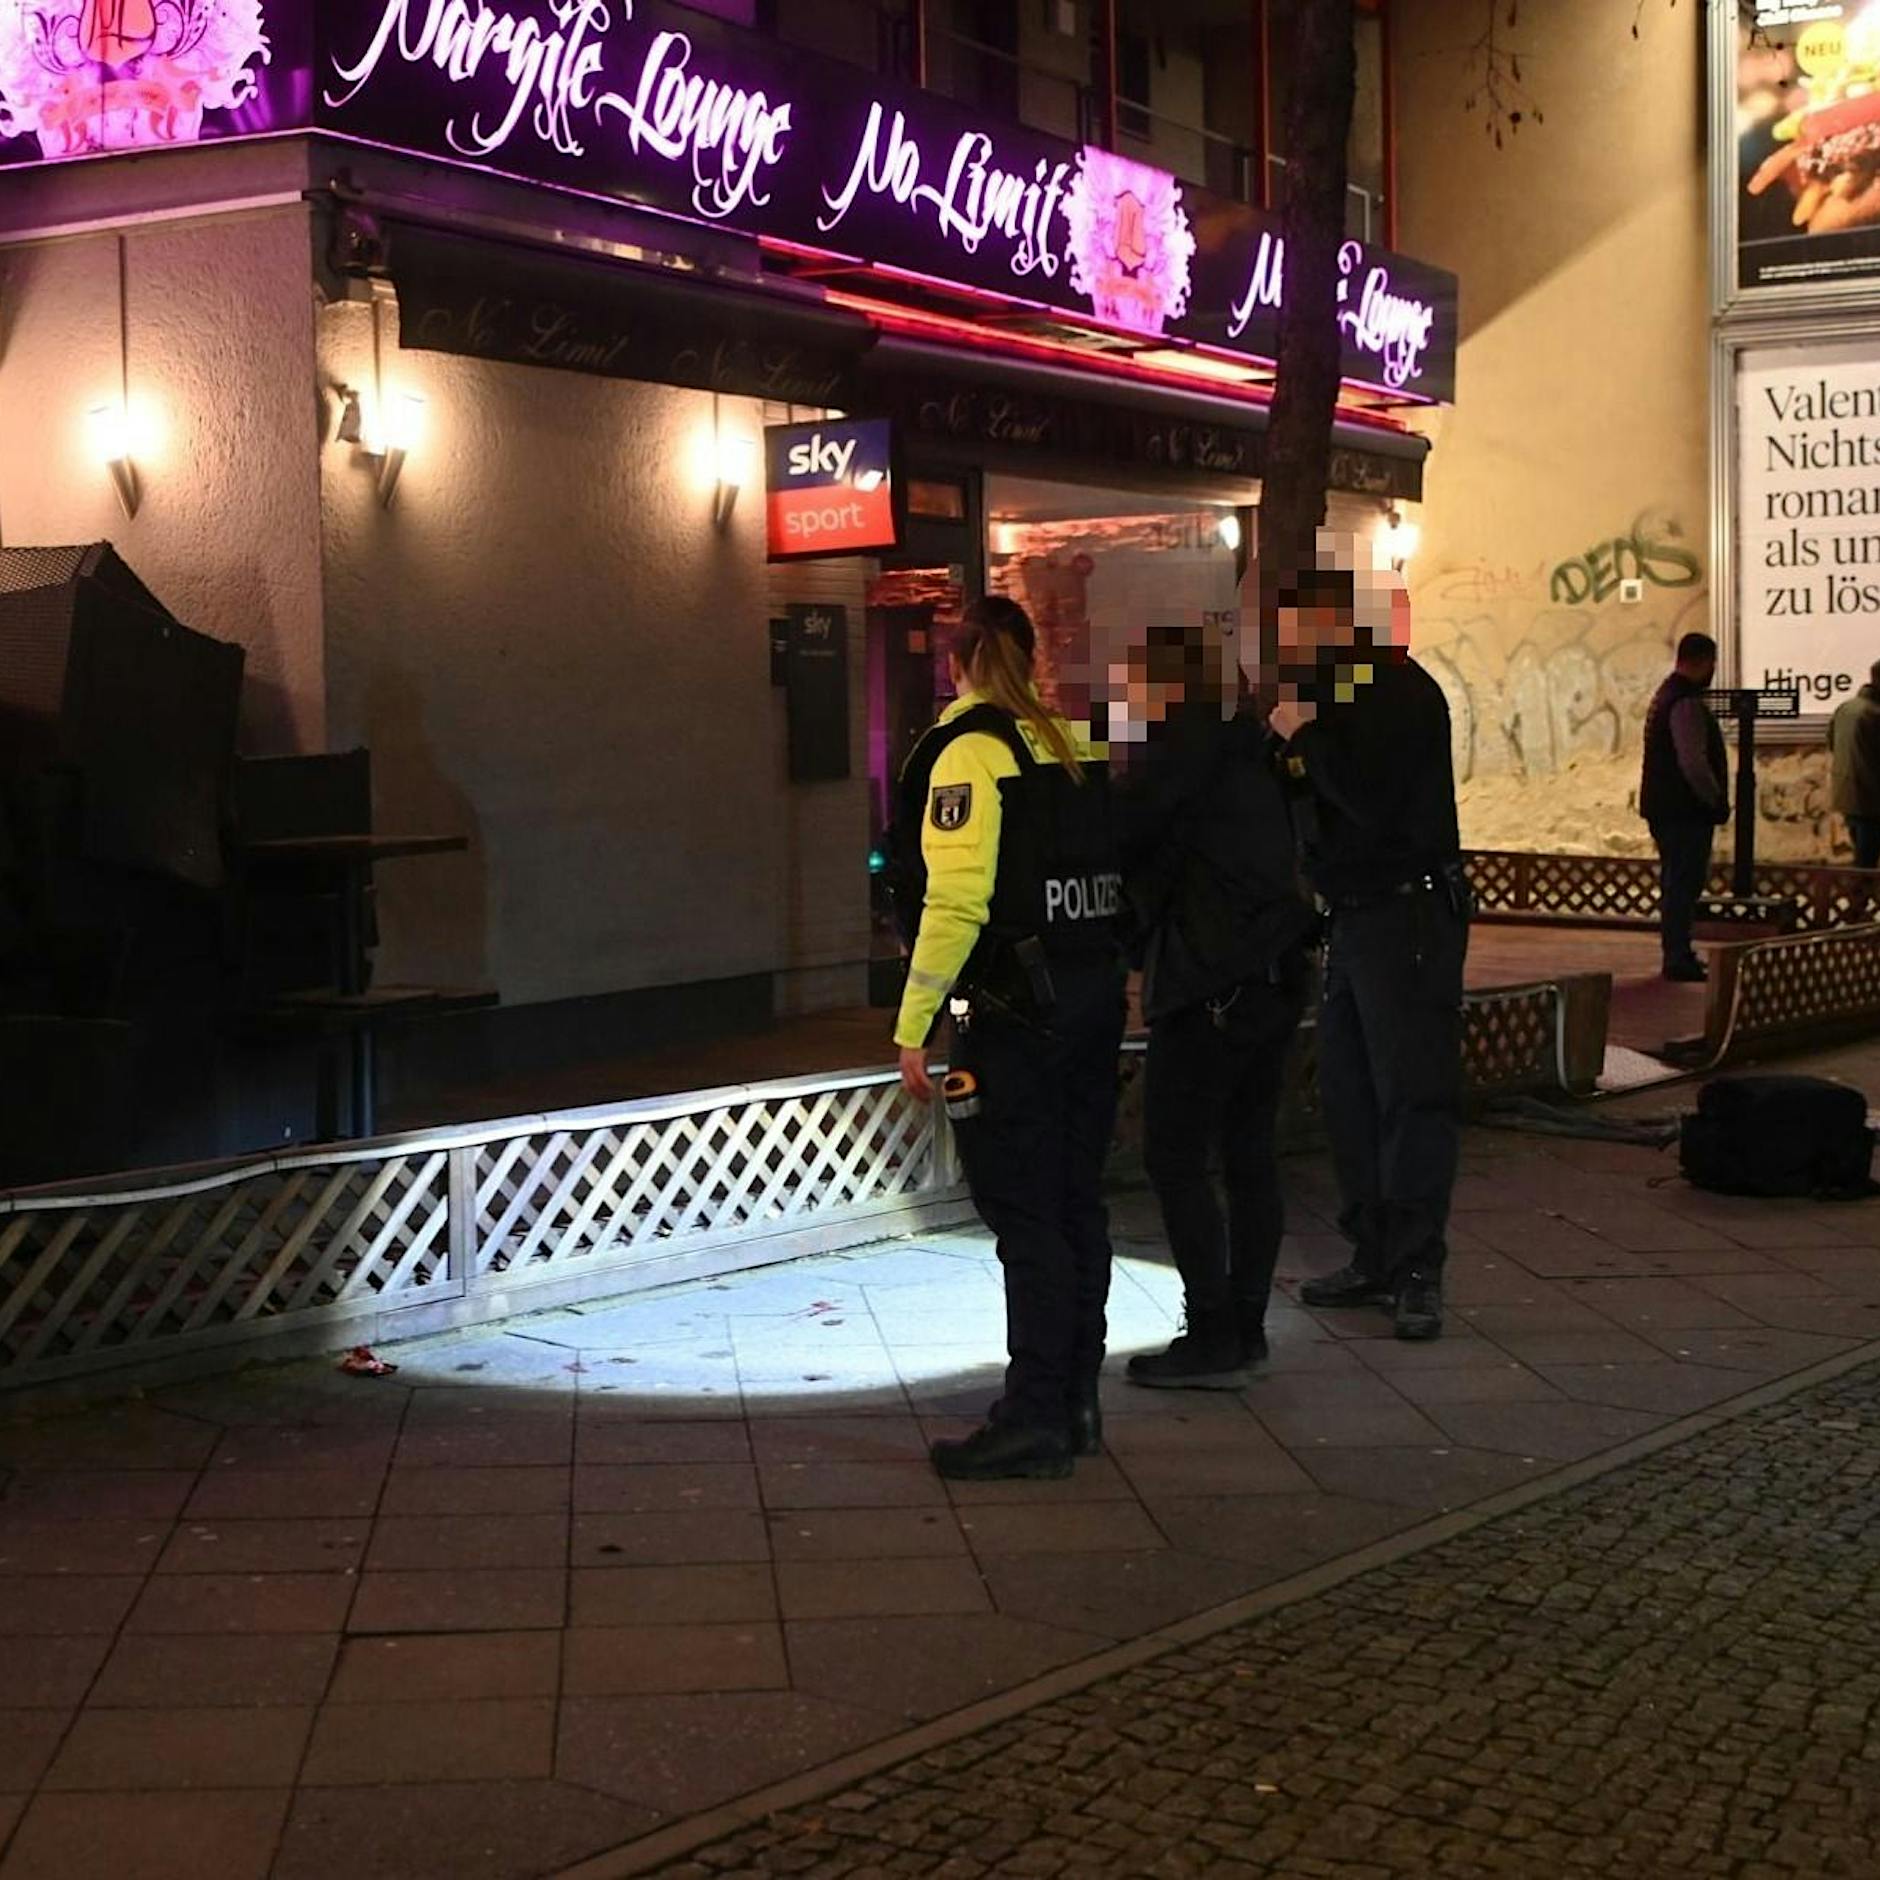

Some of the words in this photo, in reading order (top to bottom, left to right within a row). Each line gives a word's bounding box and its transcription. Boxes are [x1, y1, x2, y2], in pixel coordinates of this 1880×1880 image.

[1804, 40, 1842, 58] NEU
[596, 32, 792, 218] Lounge
[816, 100, 921, 232] No
[910, 131, 1071, 279] Limit
[518, 306, 632, 370] Limit
[787, 433, 858, 480] sky
[784, 501, 867, 539] sport
[1764, 527, 1821, 568] als
[1765, 586, 1813, 617] zu
[1825, 573, 1880, 616] lös
[803, 610, 833, 641] sky
[1763, 667, 1853, 702] Hinge
